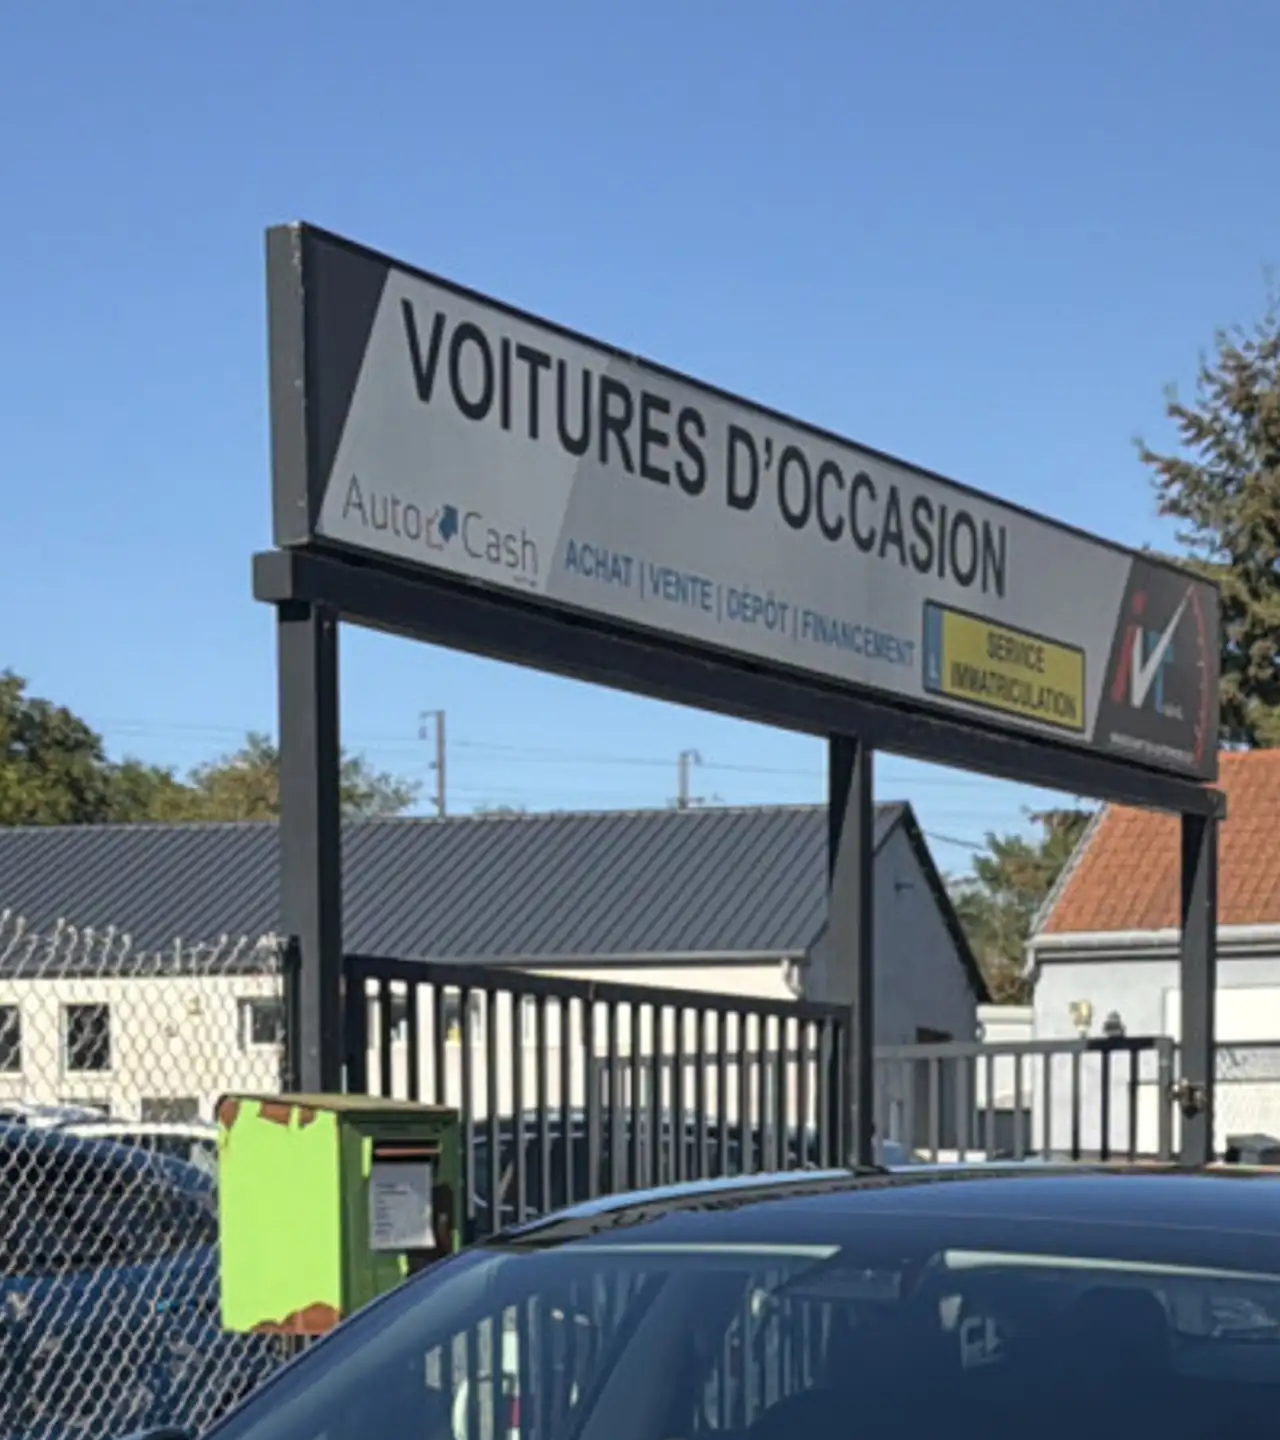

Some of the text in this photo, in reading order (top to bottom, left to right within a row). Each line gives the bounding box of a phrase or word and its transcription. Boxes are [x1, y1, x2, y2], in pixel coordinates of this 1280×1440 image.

[402, 298, 707, 496] VOITURES
[564, 538, 633, 588] ACHAT
[649, 562, 714, 612] VENTE
[801, 610, 916, 667] FINANCEMENT
